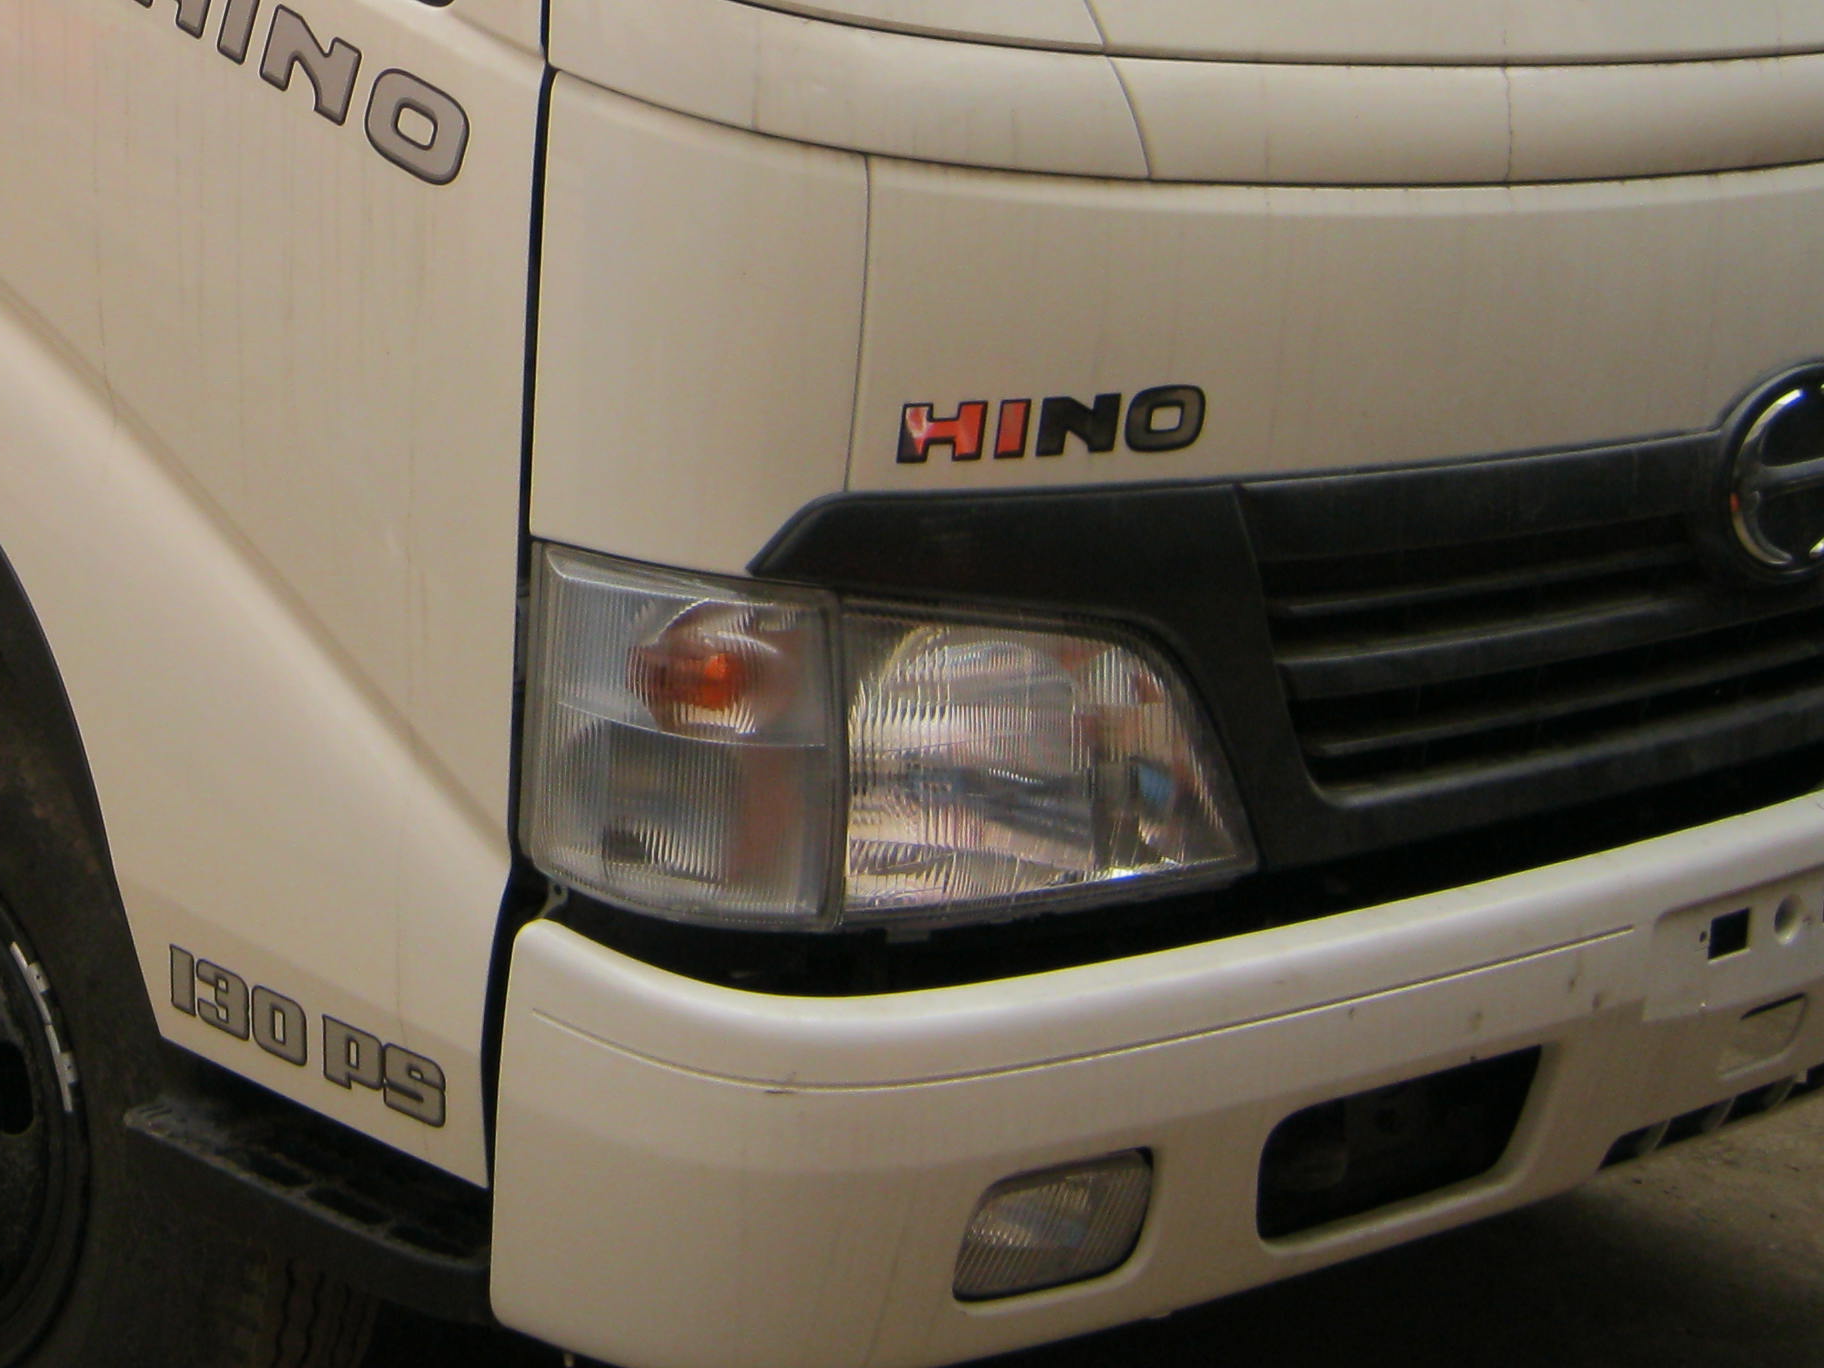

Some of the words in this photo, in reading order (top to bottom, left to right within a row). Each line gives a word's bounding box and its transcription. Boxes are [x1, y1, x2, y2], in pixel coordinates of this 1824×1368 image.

[896, 384, 1207, 464] HINO
[169, 944, 308, 1066] 130
[322, 1014, 446, 1128] PS
